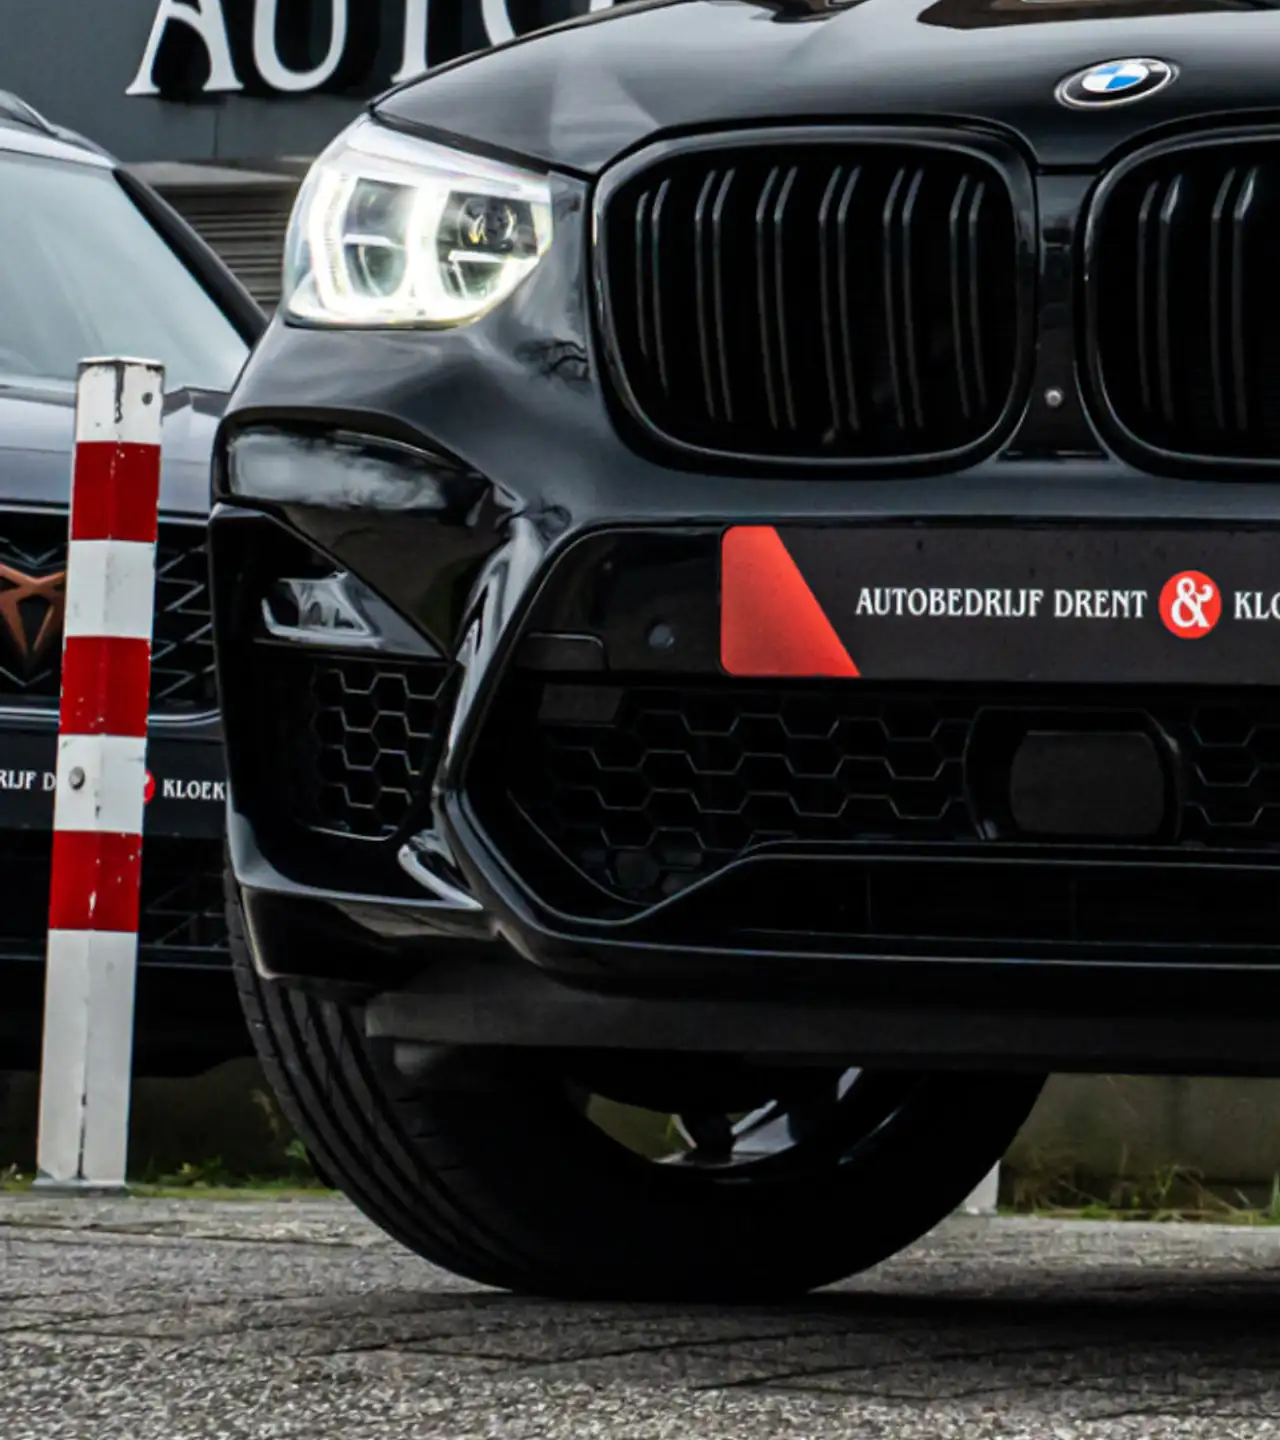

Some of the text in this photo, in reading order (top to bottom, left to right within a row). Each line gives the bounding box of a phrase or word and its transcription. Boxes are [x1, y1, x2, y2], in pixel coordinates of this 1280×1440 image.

[855, 587, 1045, 617] AUTOBEDRIJF
[1053, 589, 1148, 618] DRENT
[1170, 577, 1214, 628] &
[162, 779, 226, 801] KLOEK
